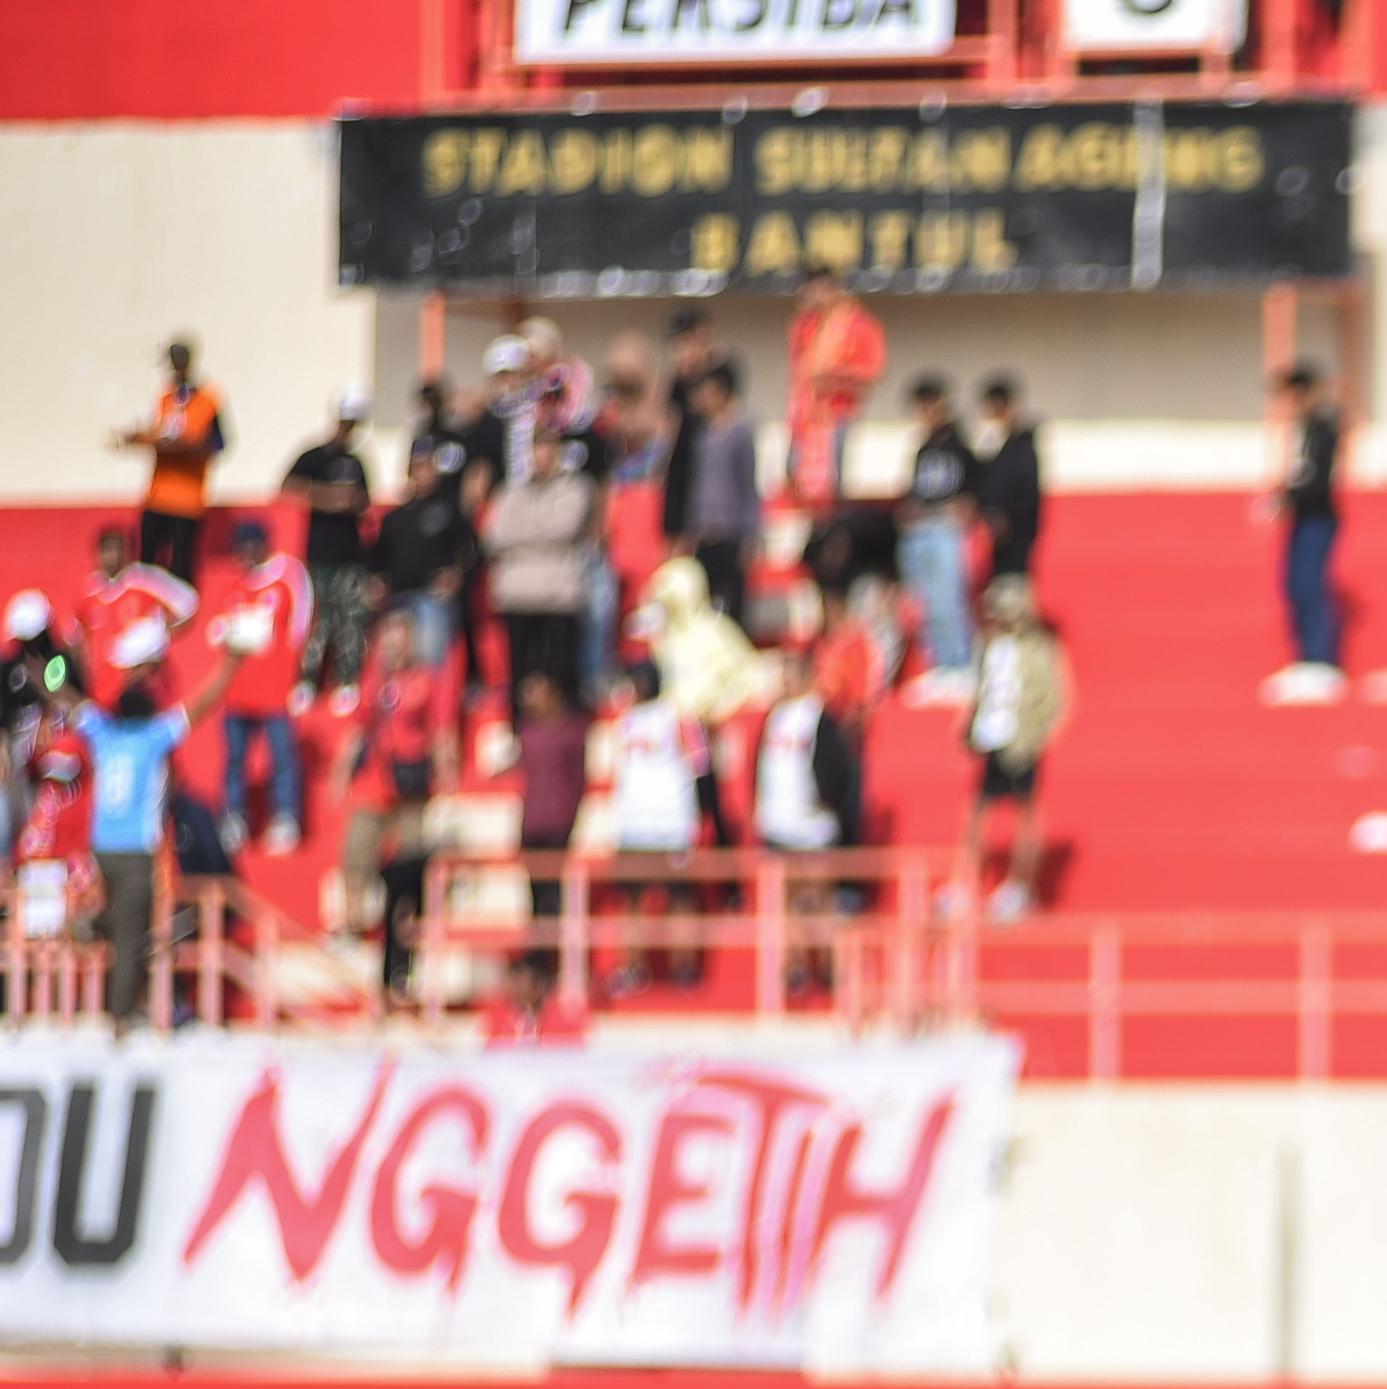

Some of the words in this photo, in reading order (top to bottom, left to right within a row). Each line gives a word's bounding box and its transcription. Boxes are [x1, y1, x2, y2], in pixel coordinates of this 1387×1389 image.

[422, 123, 734, 198] STADION
[753, 124, 1012, 196] SULTAN
[690, 208, 1020, 278] BANTUL
